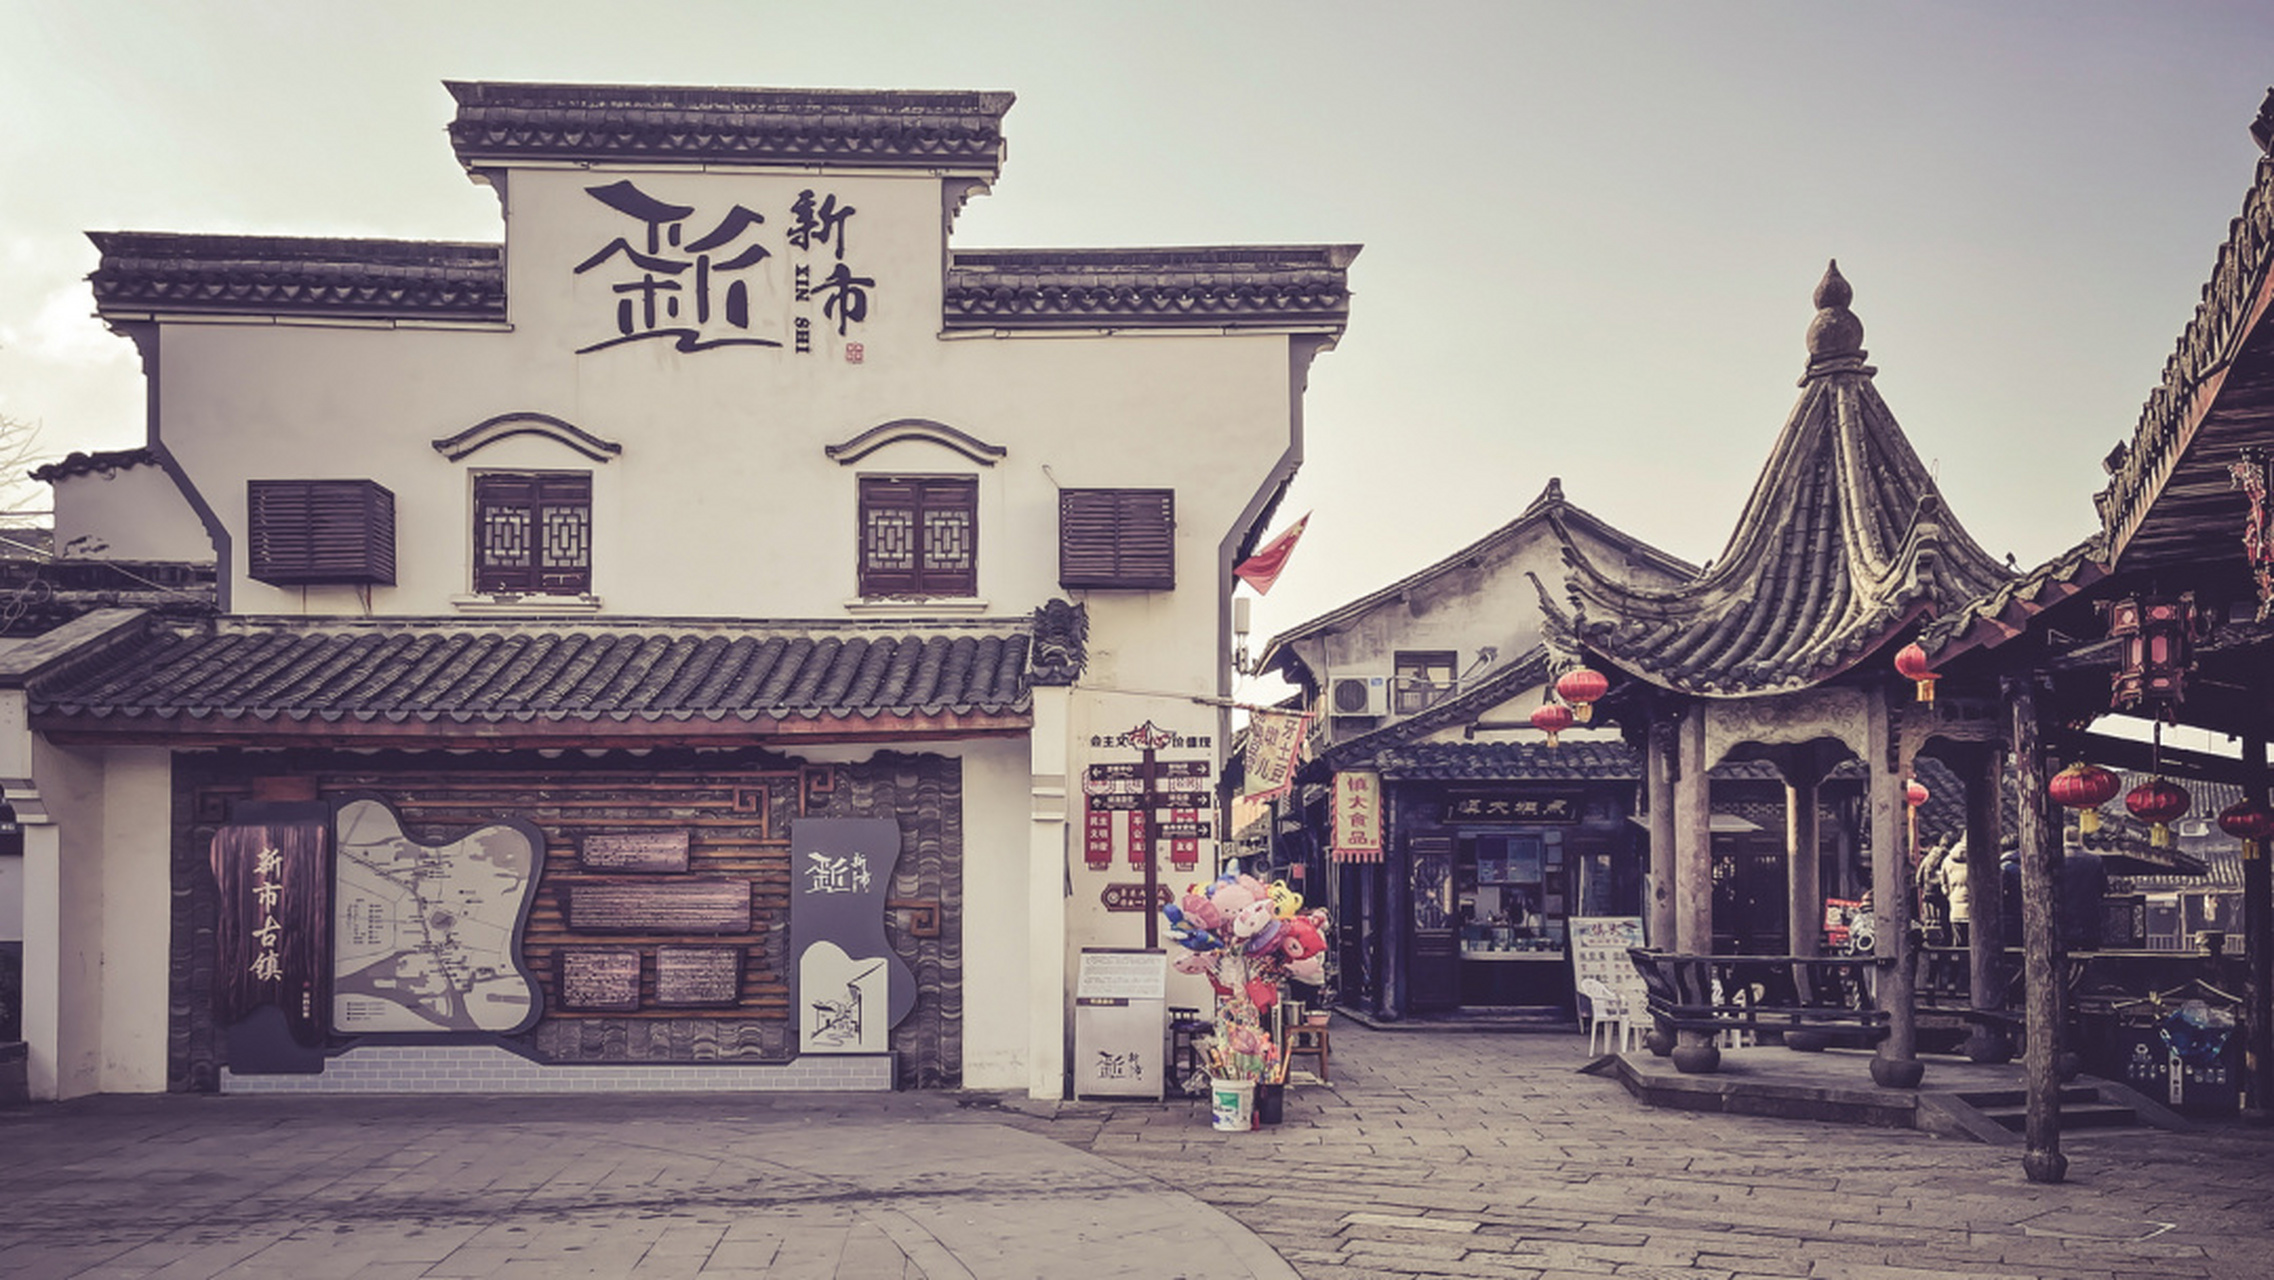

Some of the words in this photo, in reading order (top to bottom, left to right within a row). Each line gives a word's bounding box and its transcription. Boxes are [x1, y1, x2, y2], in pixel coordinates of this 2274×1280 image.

[787, 189, 876, 337] 新市
[795, 264, 810, 302] XIN
[793, 317, 810, 354] SHI
[249, 848, 283, 981] 新市古镇
